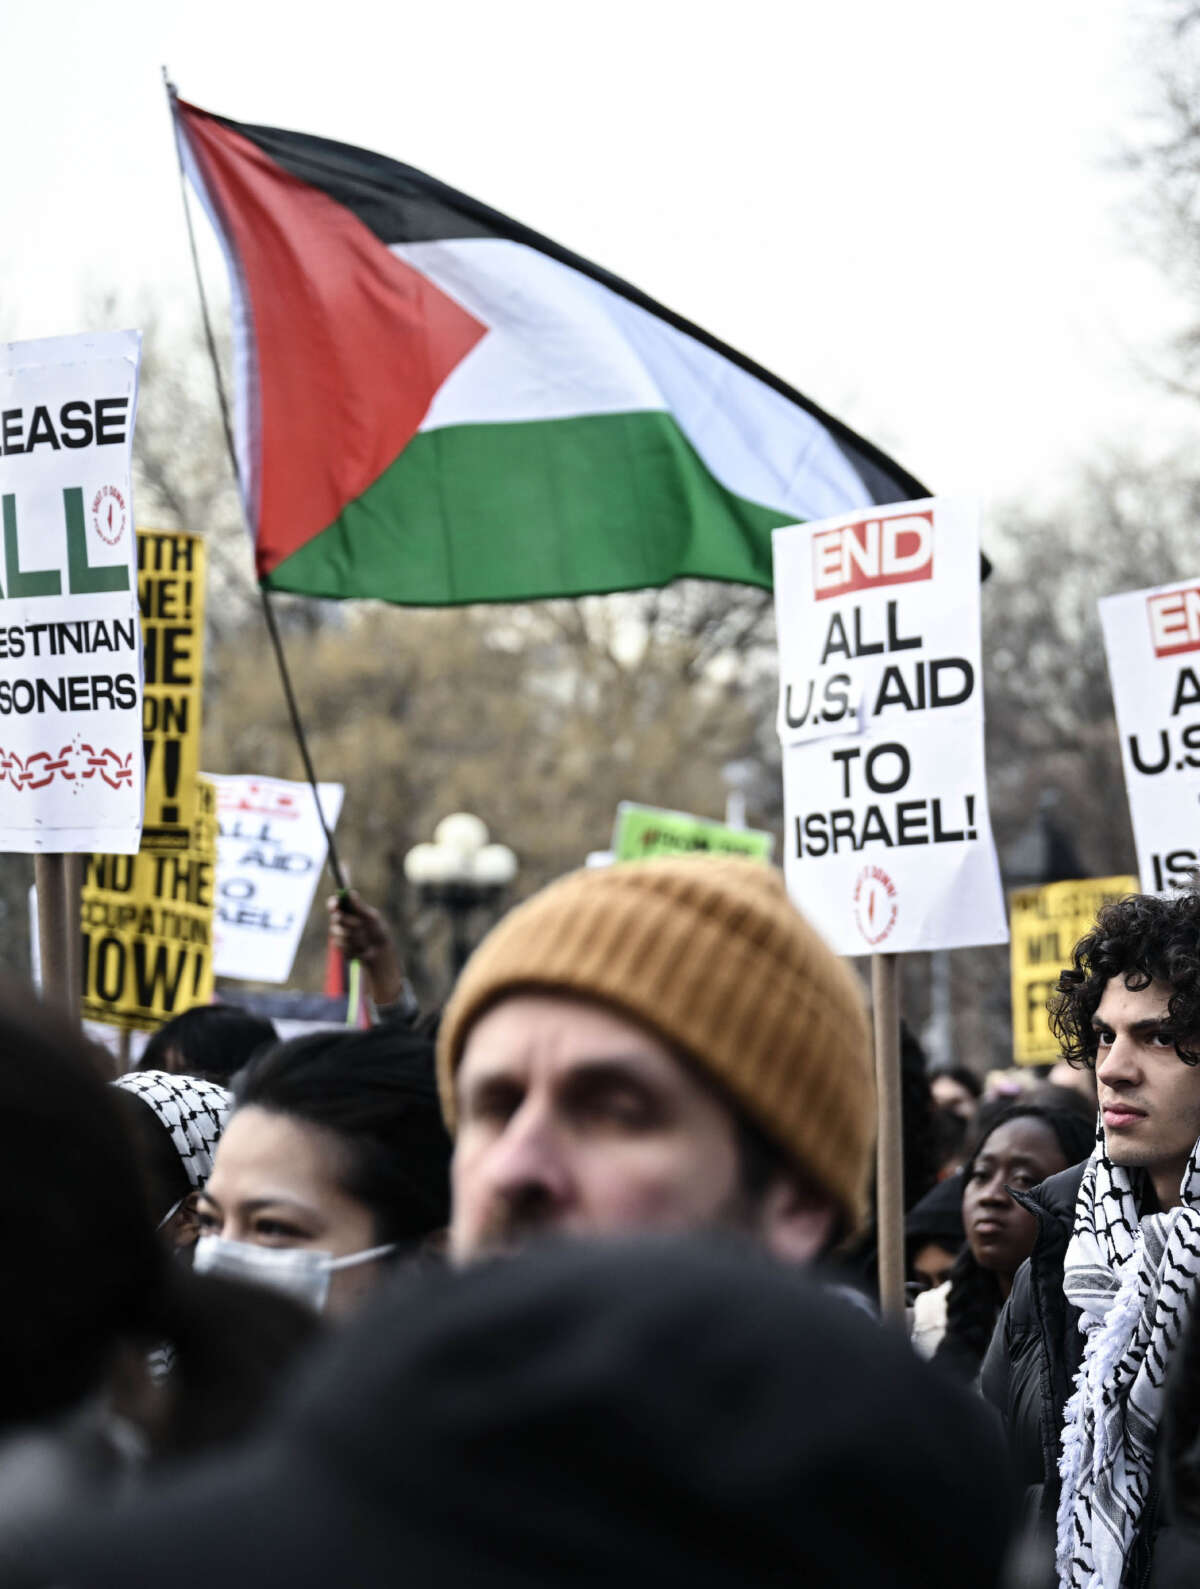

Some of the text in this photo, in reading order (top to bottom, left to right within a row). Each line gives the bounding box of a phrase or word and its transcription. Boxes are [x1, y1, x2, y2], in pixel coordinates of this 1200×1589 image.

[0, 397, 129, 456] EASE
[0, 486, 130, 599] LL
[138, 535, 192, 571] ITH
[815, 516, 933, 588] END
[0, 618, 136, 658] ESTINIAN
[819, 600, 923, 665] ALL
[0, 673, 138, 714] SONERS
[785, 657, 975, 729] U.S. AID
[832, 741, 911, 799] TO
[795, 795, 978, 859] ISRAEL!
[154, 857, 211, 907] THE
